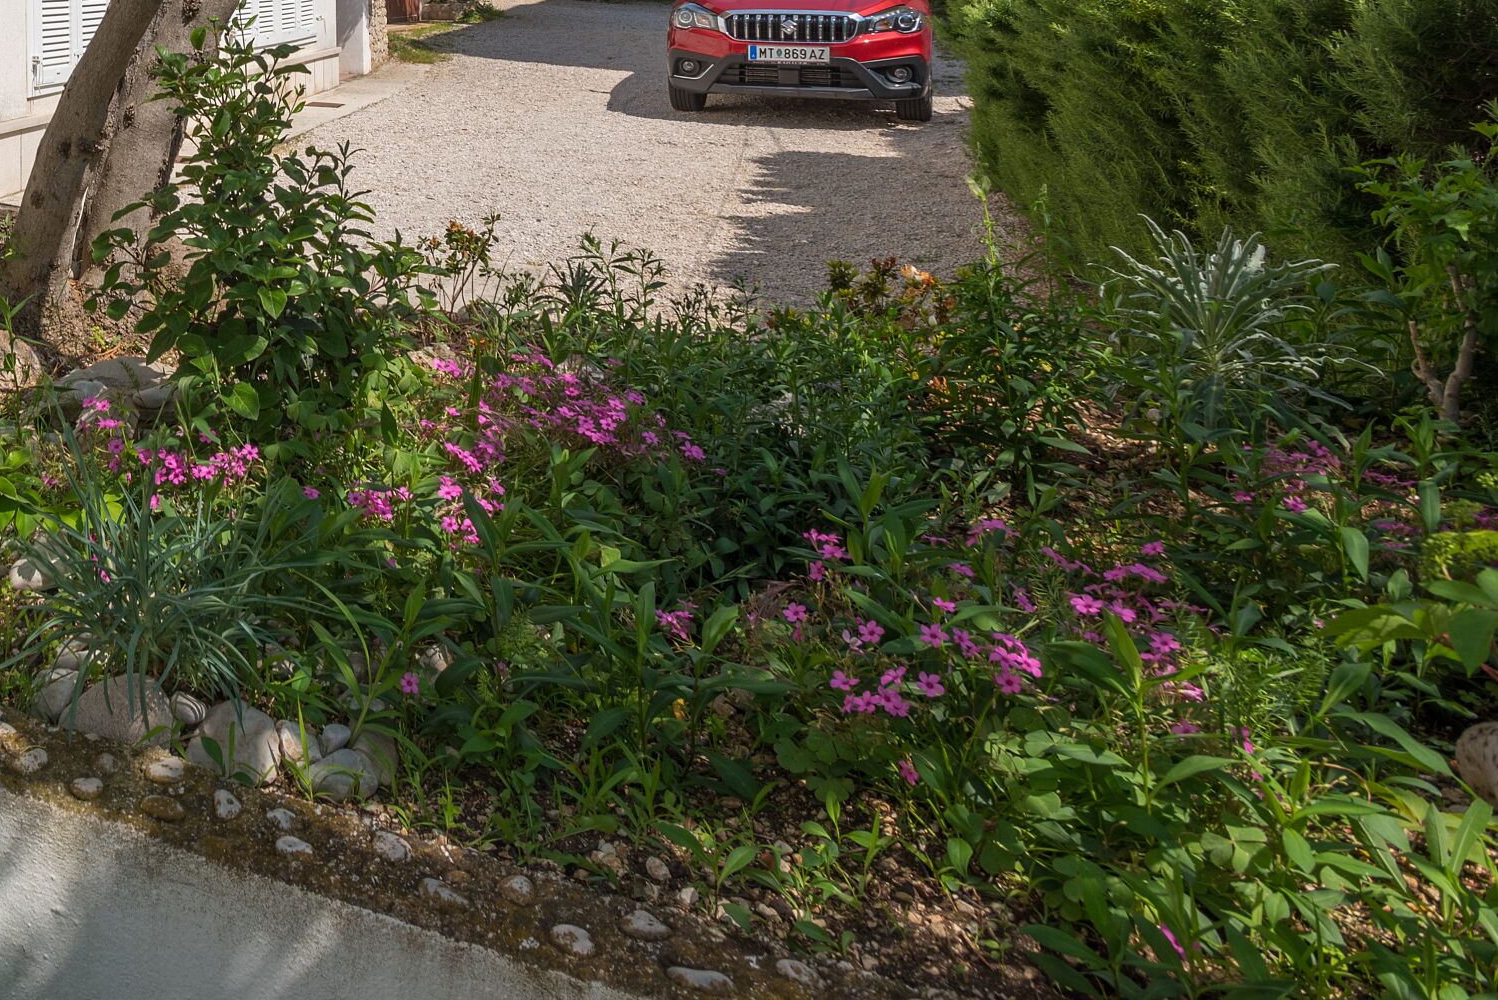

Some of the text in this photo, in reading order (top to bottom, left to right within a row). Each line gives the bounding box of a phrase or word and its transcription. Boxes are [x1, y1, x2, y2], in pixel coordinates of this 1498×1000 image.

[759, 48, 774, 58] MT
[784, 49, 807, 59] 869
[809, 49, 825, 60] AZ
